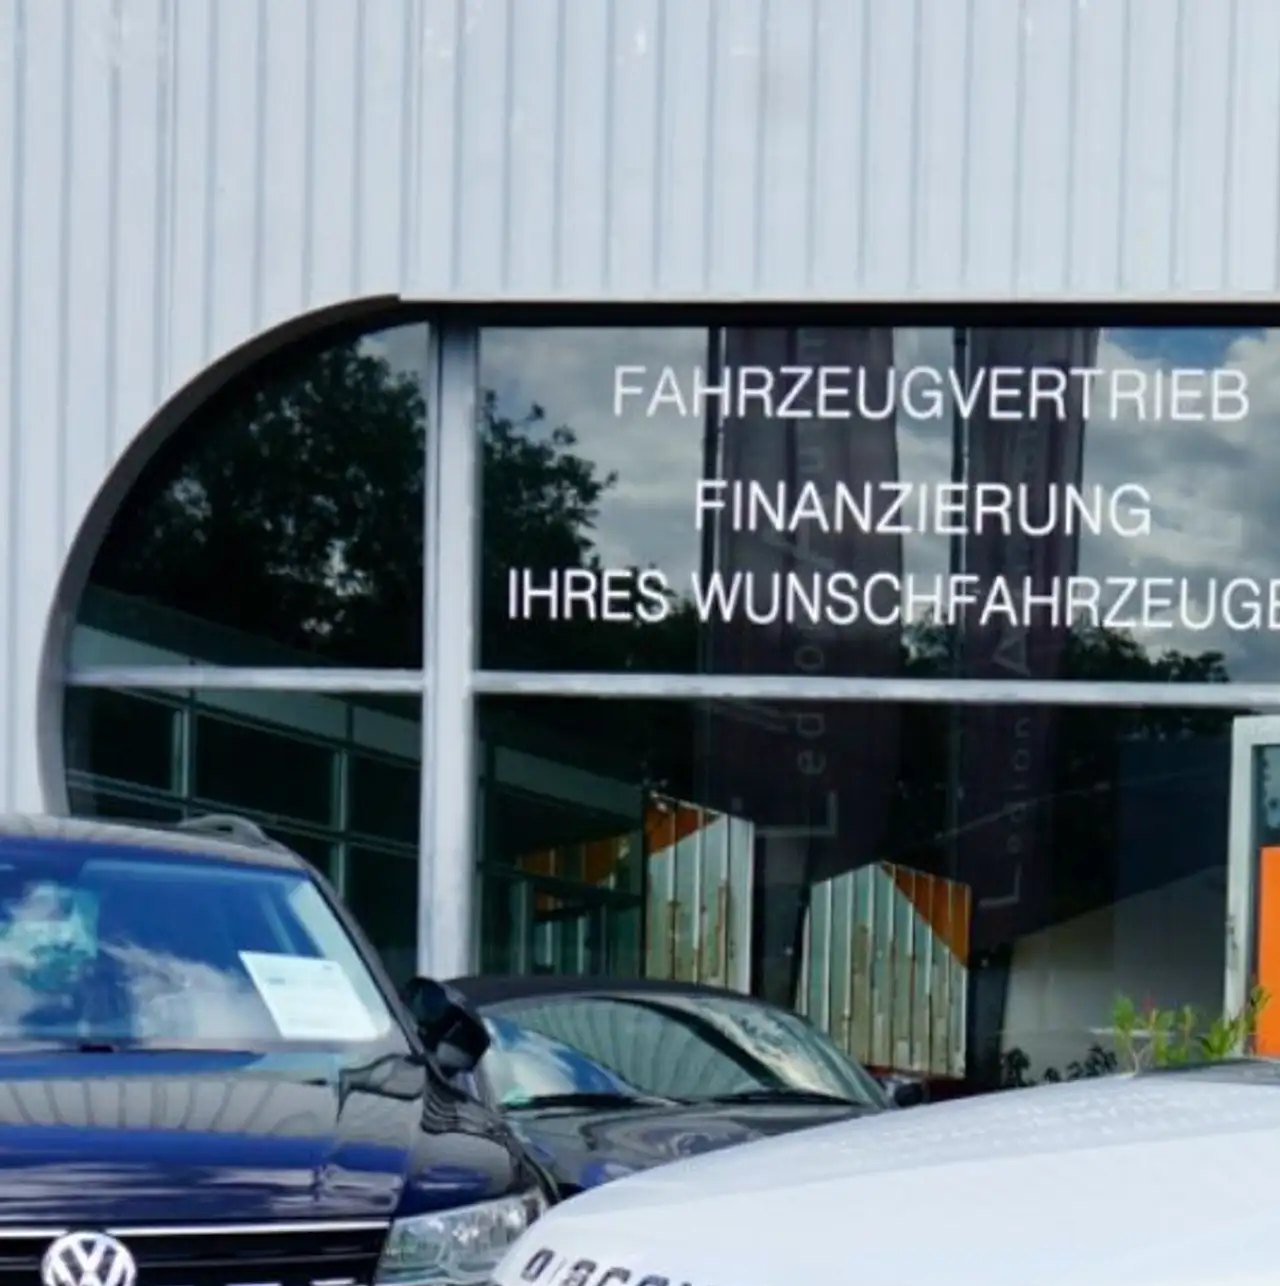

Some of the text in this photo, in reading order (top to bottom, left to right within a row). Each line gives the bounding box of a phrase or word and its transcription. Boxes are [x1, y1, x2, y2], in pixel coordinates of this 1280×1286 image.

[613, 365, 1251, 423] FAHRZEUGVERTRIEB
[694, 478, 1152, 539] FINANZIERUNG
[509, 568, 669, 622] IHRES
